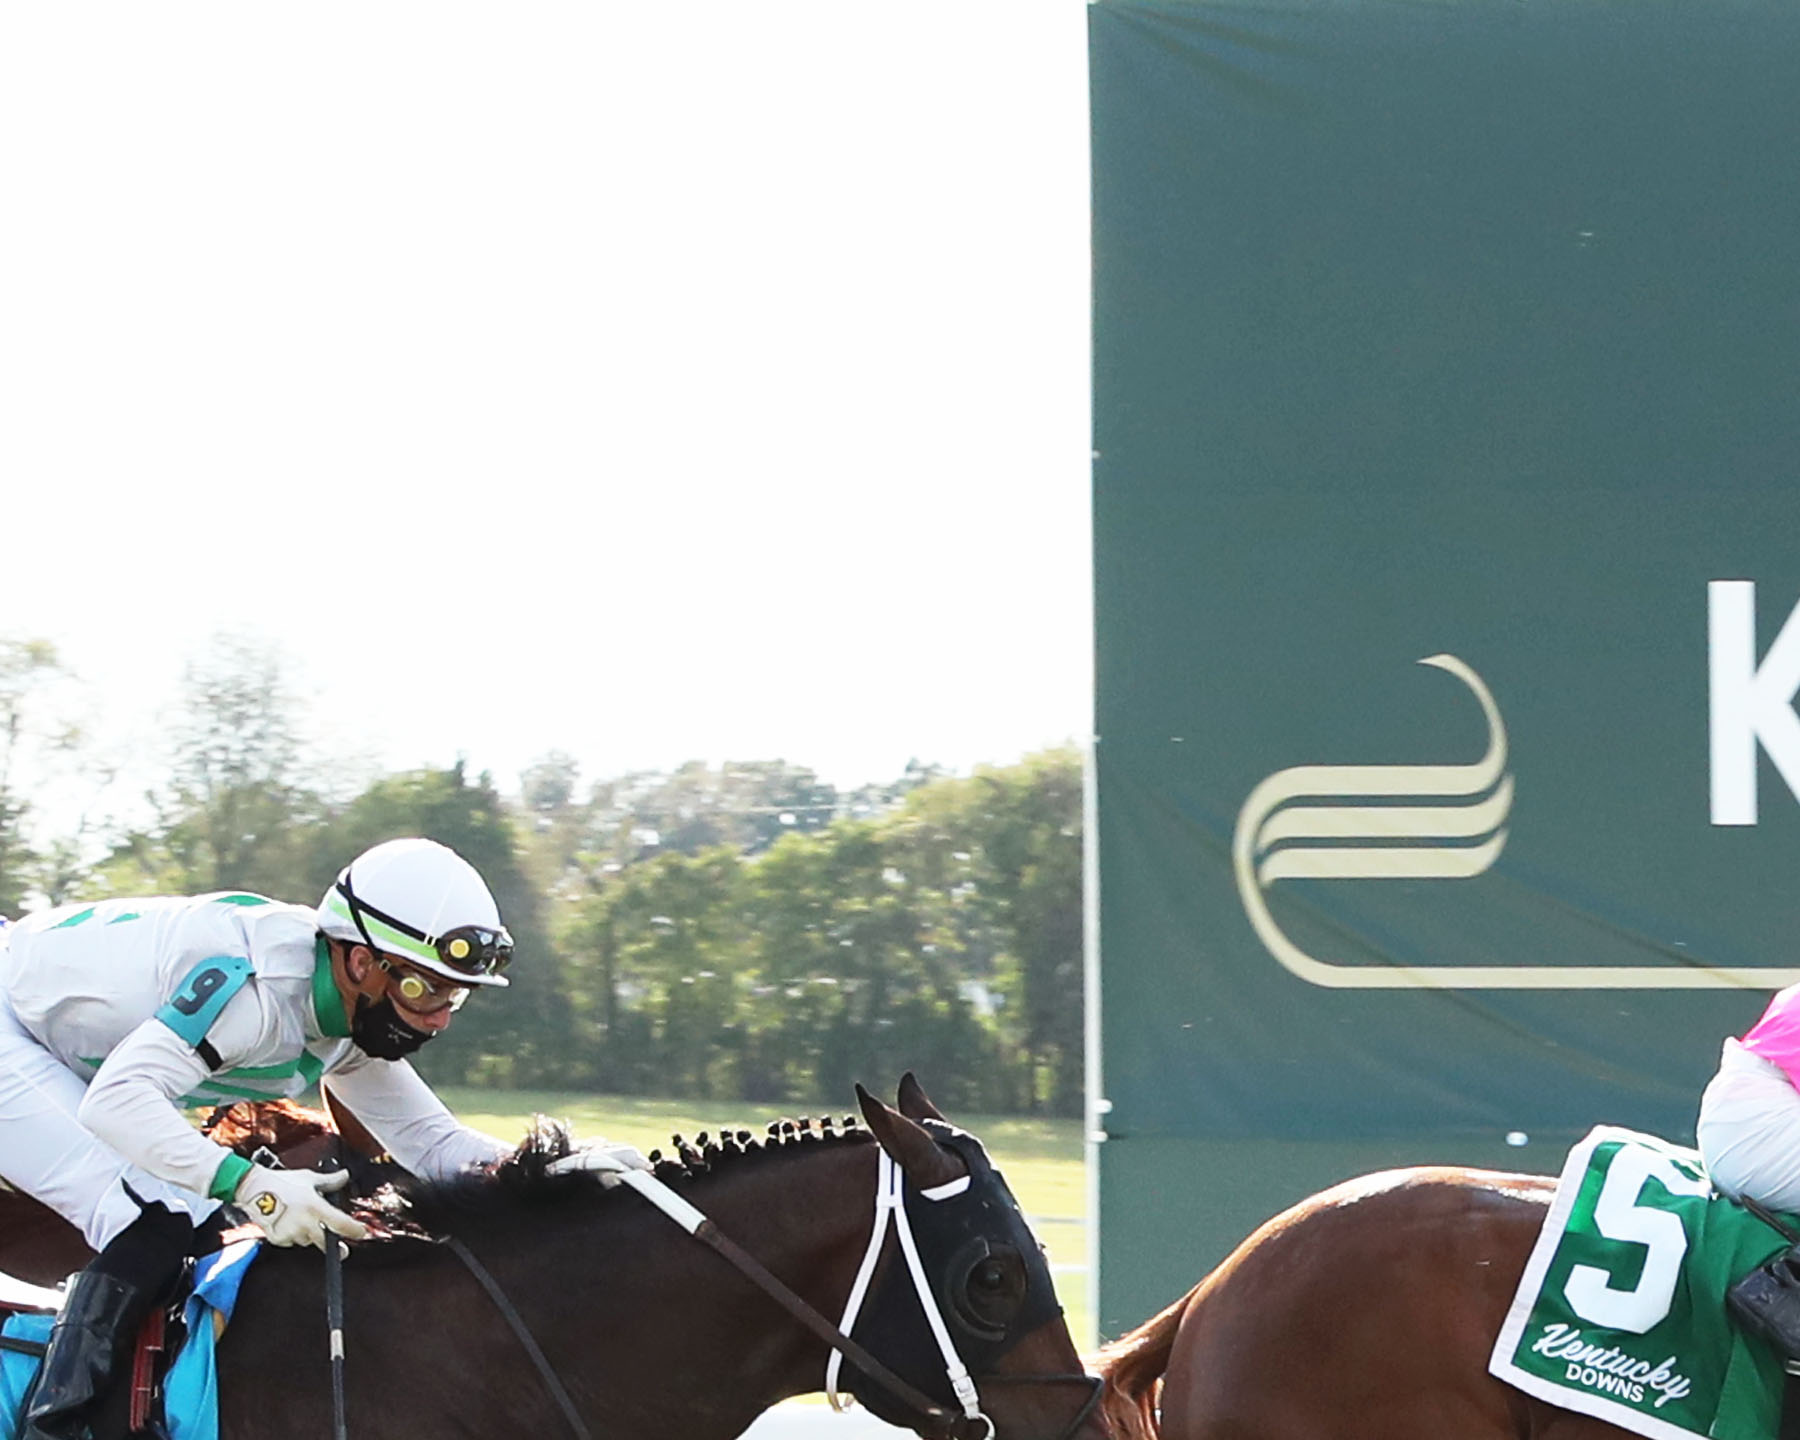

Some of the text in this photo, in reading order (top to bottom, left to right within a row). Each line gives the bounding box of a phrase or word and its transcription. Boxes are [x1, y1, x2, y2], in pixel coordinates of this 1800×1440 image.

[172, 968, 228, 1016] 9
[1563, 1143, 1713, 1335] 5
[1531, 1322, 1691, 1409] Kentucky
[1565, 1362, 1646, 1403] DOWNS
